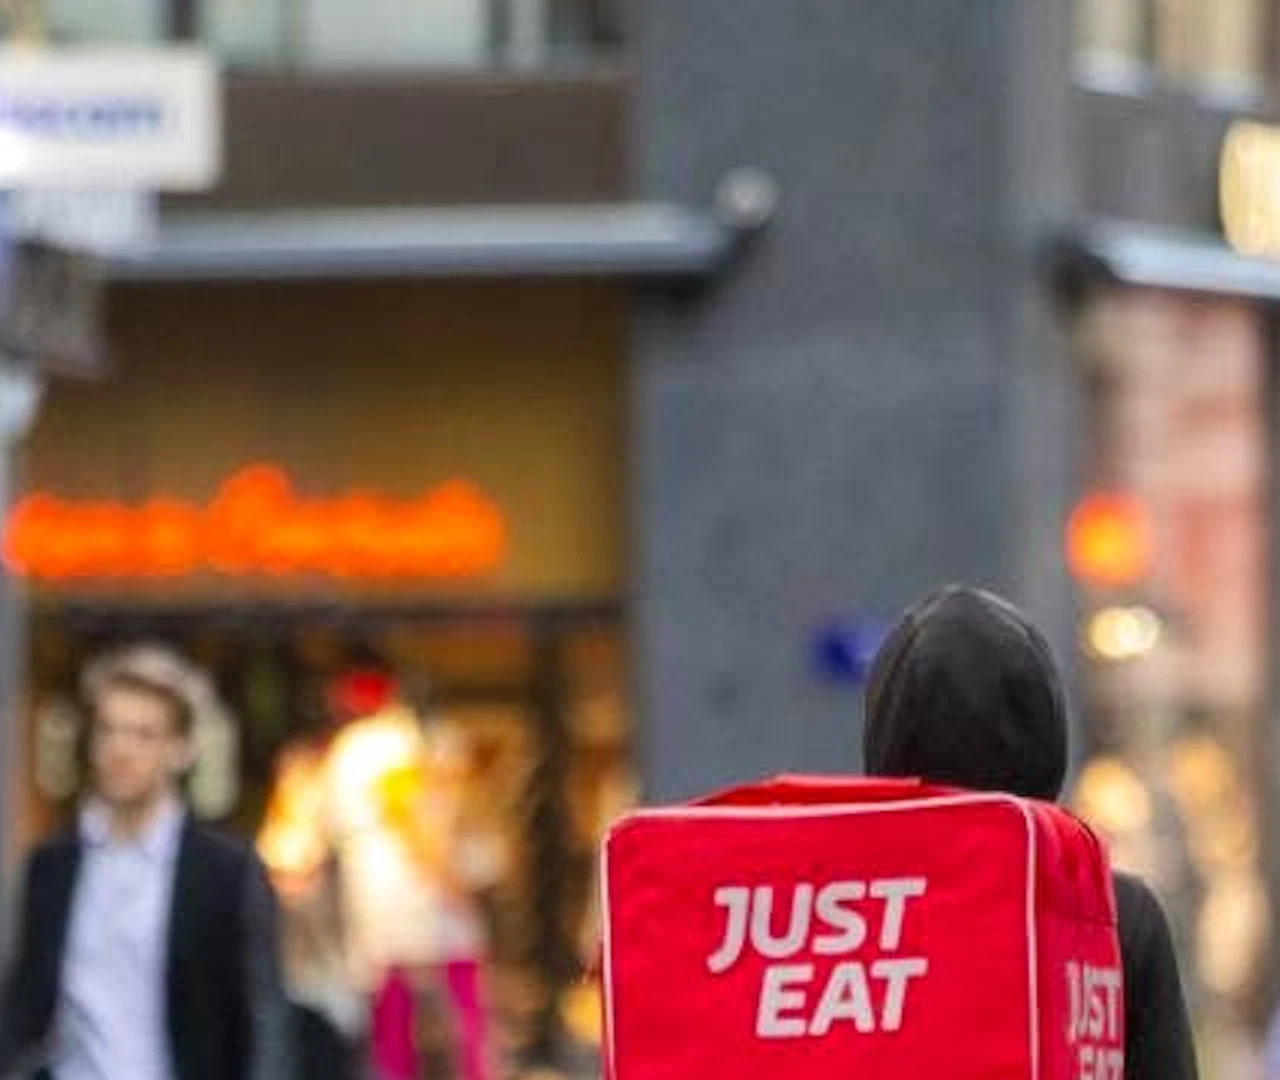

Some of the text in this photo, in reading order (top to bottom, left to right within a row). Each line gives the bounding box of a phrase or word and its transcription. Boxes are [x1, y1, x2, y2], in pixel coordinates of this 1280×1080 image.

[707, 877, 927, 973] JUST
[756, 957, 928, 1038] EAT
[1065, 960, 1123, 1043] JUST
